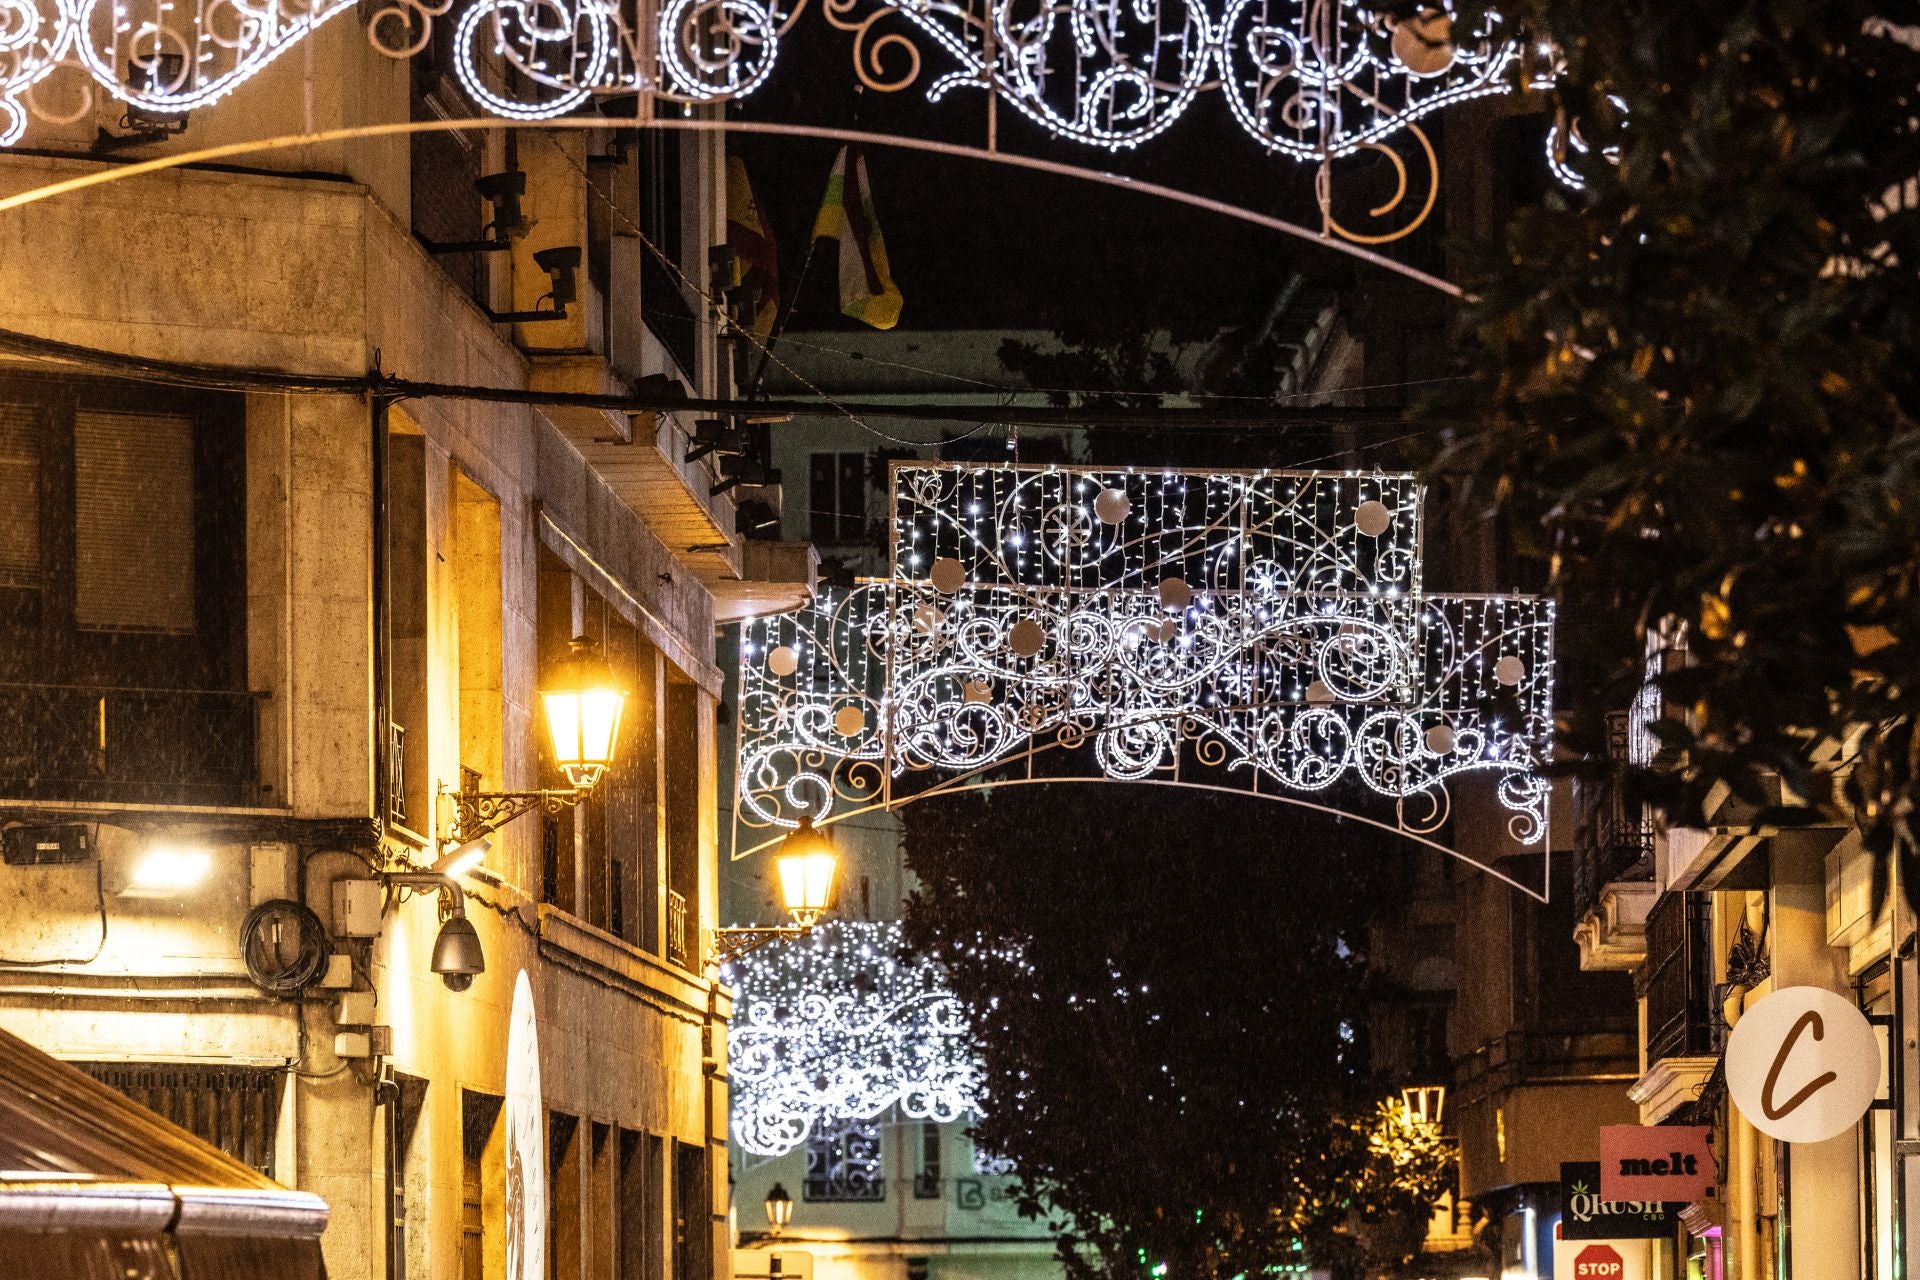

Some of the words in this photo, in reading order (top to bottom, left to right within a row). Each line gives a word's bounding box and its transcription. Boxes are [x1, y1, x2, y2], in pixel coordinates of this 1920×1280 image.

[1761, 1009, 1837, 1121] C
[1619, 1151, 1697, 1176] melt
[1570, 1193, 1664, 1222] QRUSH
[1643, 1213, 1665, 1221] CBD
[1578, 1262, 1620, 1275] STOP
